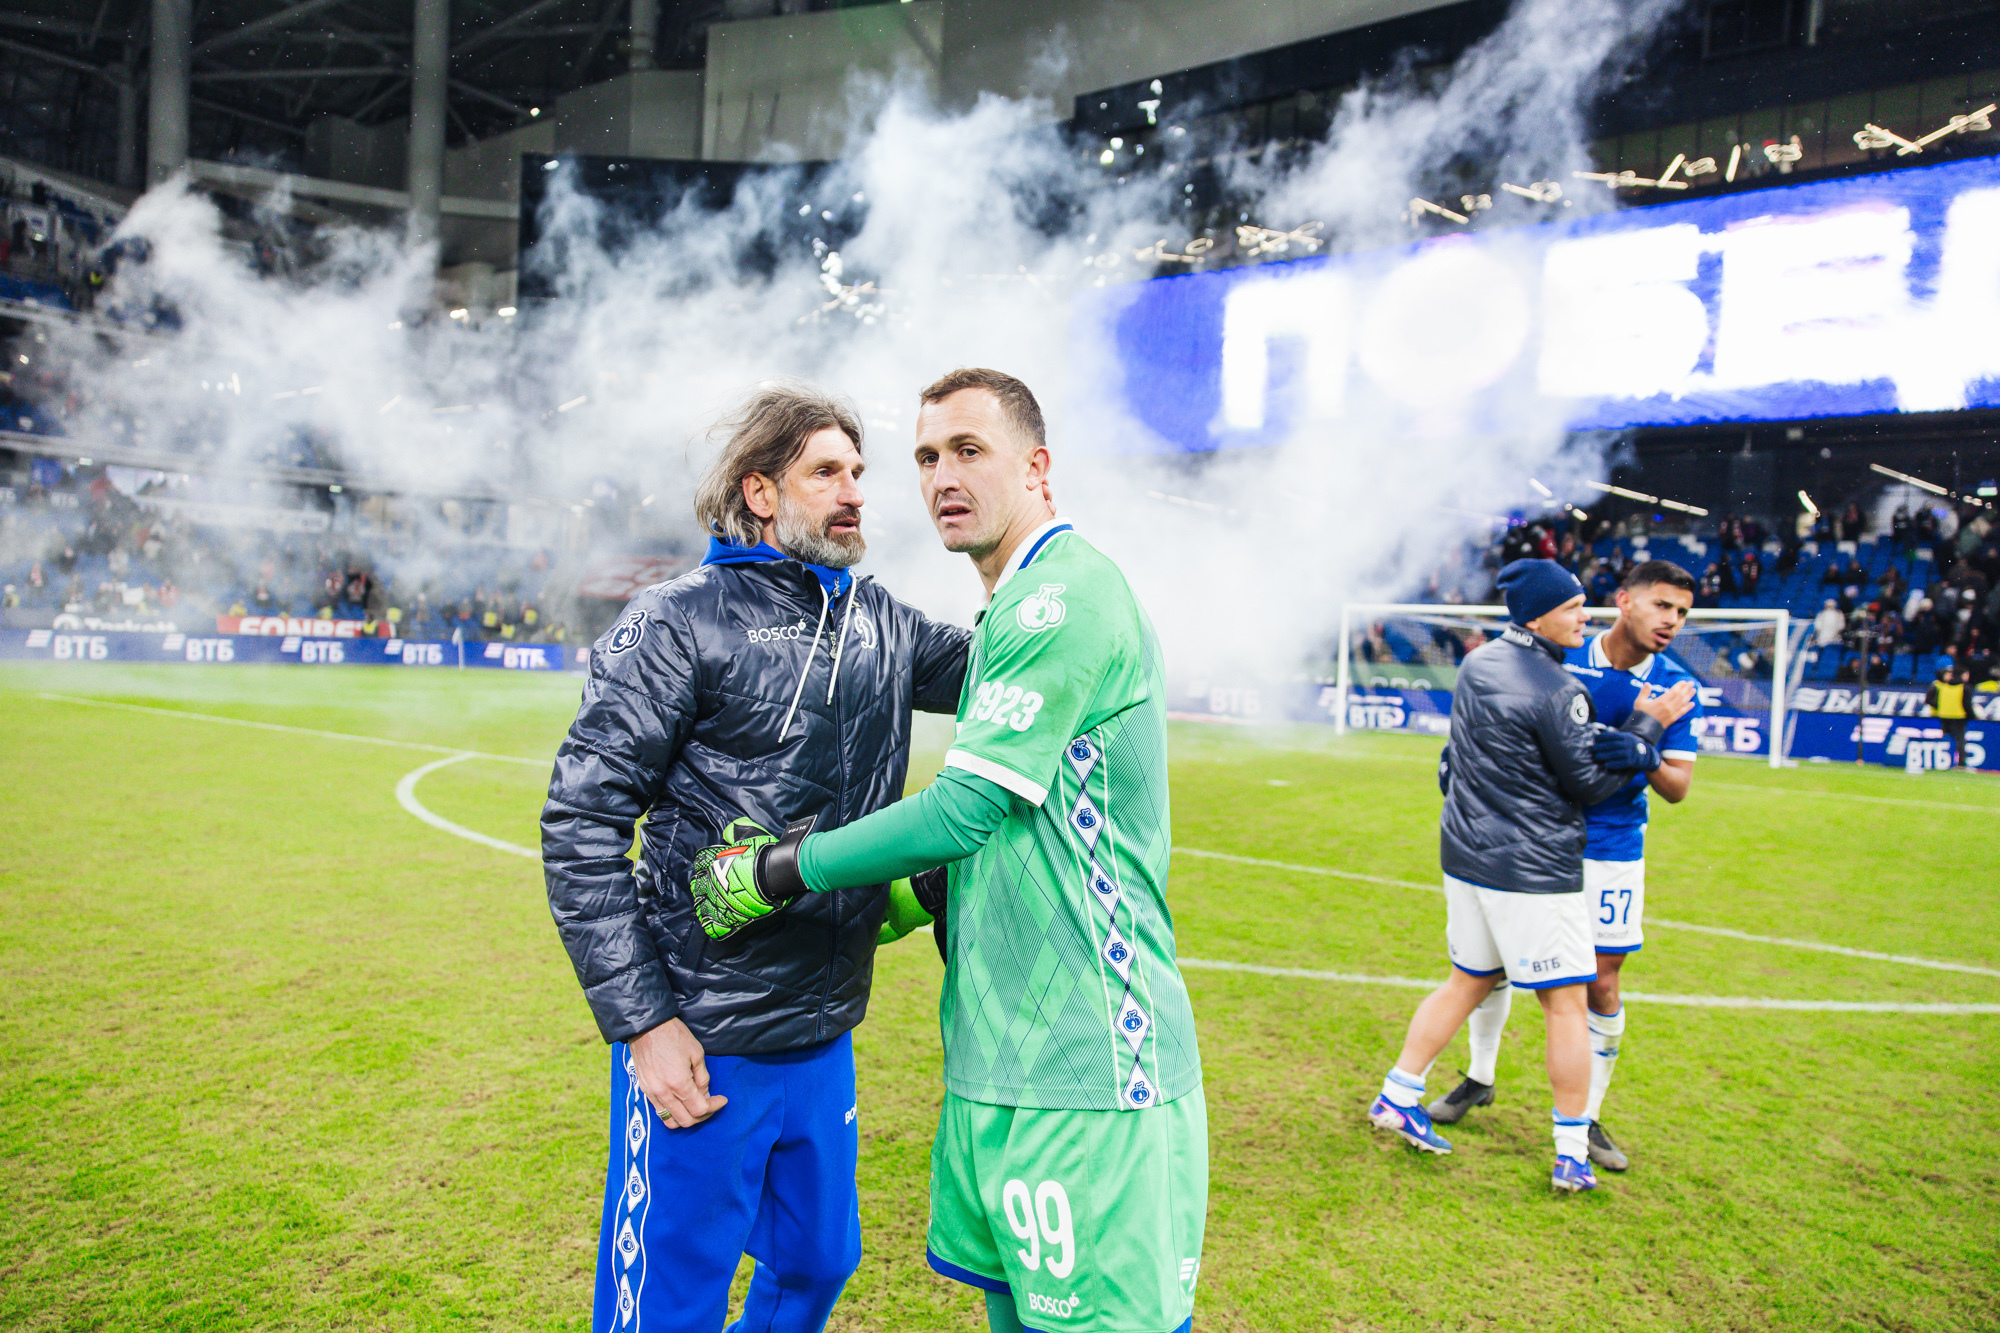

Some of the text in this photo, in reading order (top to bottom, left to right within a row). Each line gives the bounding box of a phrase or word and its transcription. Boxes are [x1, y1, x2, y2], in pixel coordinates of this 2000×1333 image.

[747, 625, 800, 643] BOSCO
[54, 635, 108, 660] ВТБ
[186, 638, 235, 662] ВТБ
[302, 641, 345, 663] ВТБ
[402, 643, 443, 665] ВТБ
[968, 681, 1044, 732] 1923
[1209, 687, 1261, 713] ВТБ
[1350, 706, 1395, 728] ВТБ
[1906, 741, 1952, 770] ВТБ
[1600, 890, 1631, 924] 57
[1533, 957, 1561, 972] ВТБ
[1003, 1179, 1075, 1279] 99
[1028, 1292, 1072, 1318] BOSCO
